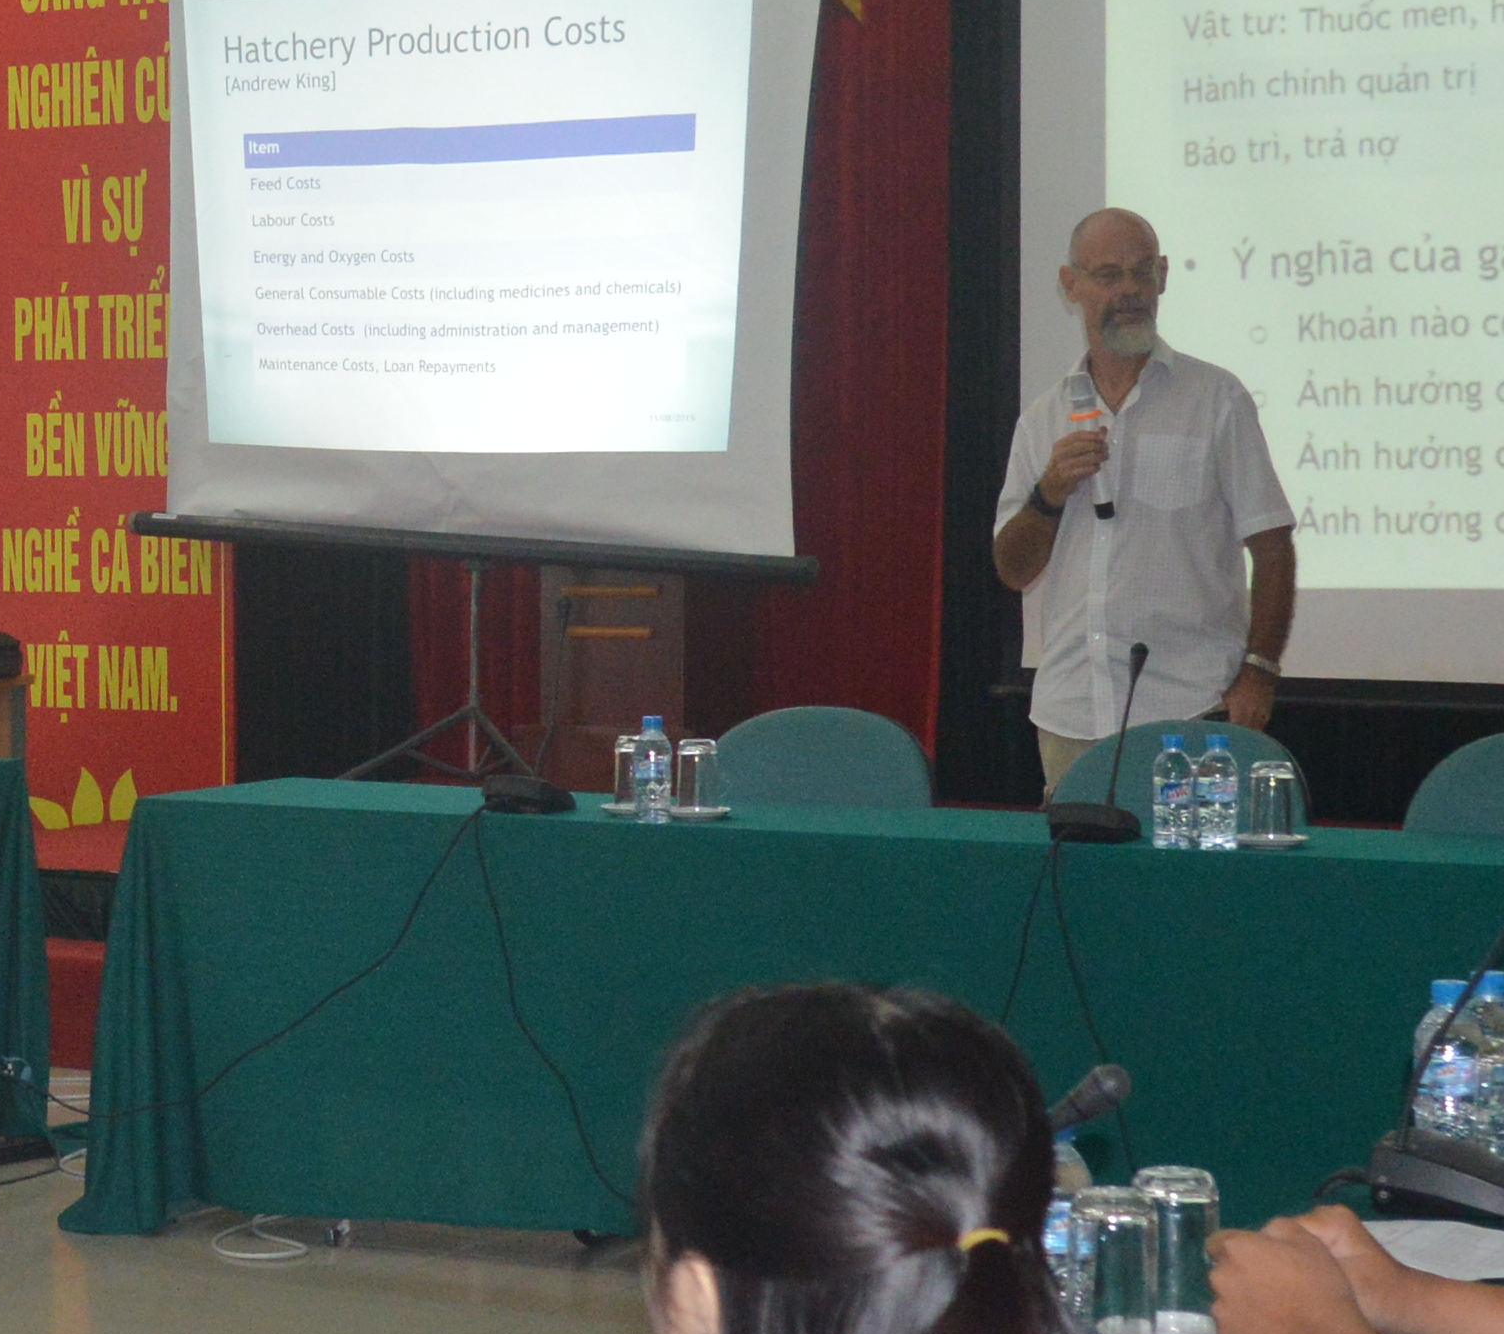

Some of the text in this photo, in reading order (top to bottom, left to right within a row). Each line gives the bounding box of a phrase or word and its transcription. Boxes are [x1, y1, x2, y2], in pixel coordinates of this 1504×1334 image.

[223, 14, 626, 65] Hatchery Production Costs
[1183, 10, 1232, 48] Vật
[1243, 10, 1288, 36] tư:
[1402, 1, 1479, 33] men,
[8, 47, 124, 129] NGHIÊN
[225, 71, 337, 95] [Andrew King]
[1184, 74, 1255, 104] Hành
[248, 140, 280, 156] Item
[1358, 134, 1399, 164] nợ
[250, 174, 321, 192] Feed Costs
[62, 164, 147, 256] VÌ SỰ
[252, 211, 335, 228] Labour Costs
[253, 248, 415, 267] Energy and Oxygen Costs
[1232, 237, 1256, 281] Ý
[1270, 239, 1374, 288] nghĩa
[1388, 232, 1462, 273] của
[15, 265, 170, 361] PHÁT TRIỂ
[255, 278, 682, 303] General Consumable Costs (including medicines and chemicals)
[257, 318, 659, 341] Overhead Costs (including administration and management)
[1297, 295, 1397, 343] Khoản
[1411, 302, 1470, 338] nào
[258, 357, 496, 377] Maintenance Costs, Loan Repayments
[1297, 369, 1361, 408] Ảnh
[1375, 370, 1483, 411] hưởng
[26, 391, 84, 476] BỀN
[1296, 431, 1361, 470] Ảnh
[1375, 435, 1482, 476] hưởng
[1296, 496, 1361, 535] Ảnh
[1375, 500, 1482, 542] hưởng
[3, 507, 81, 593] NGHỀ
[92, 515, 131, 594] CÁ
[27, 631, 177, 723] VIỆT NAM.
